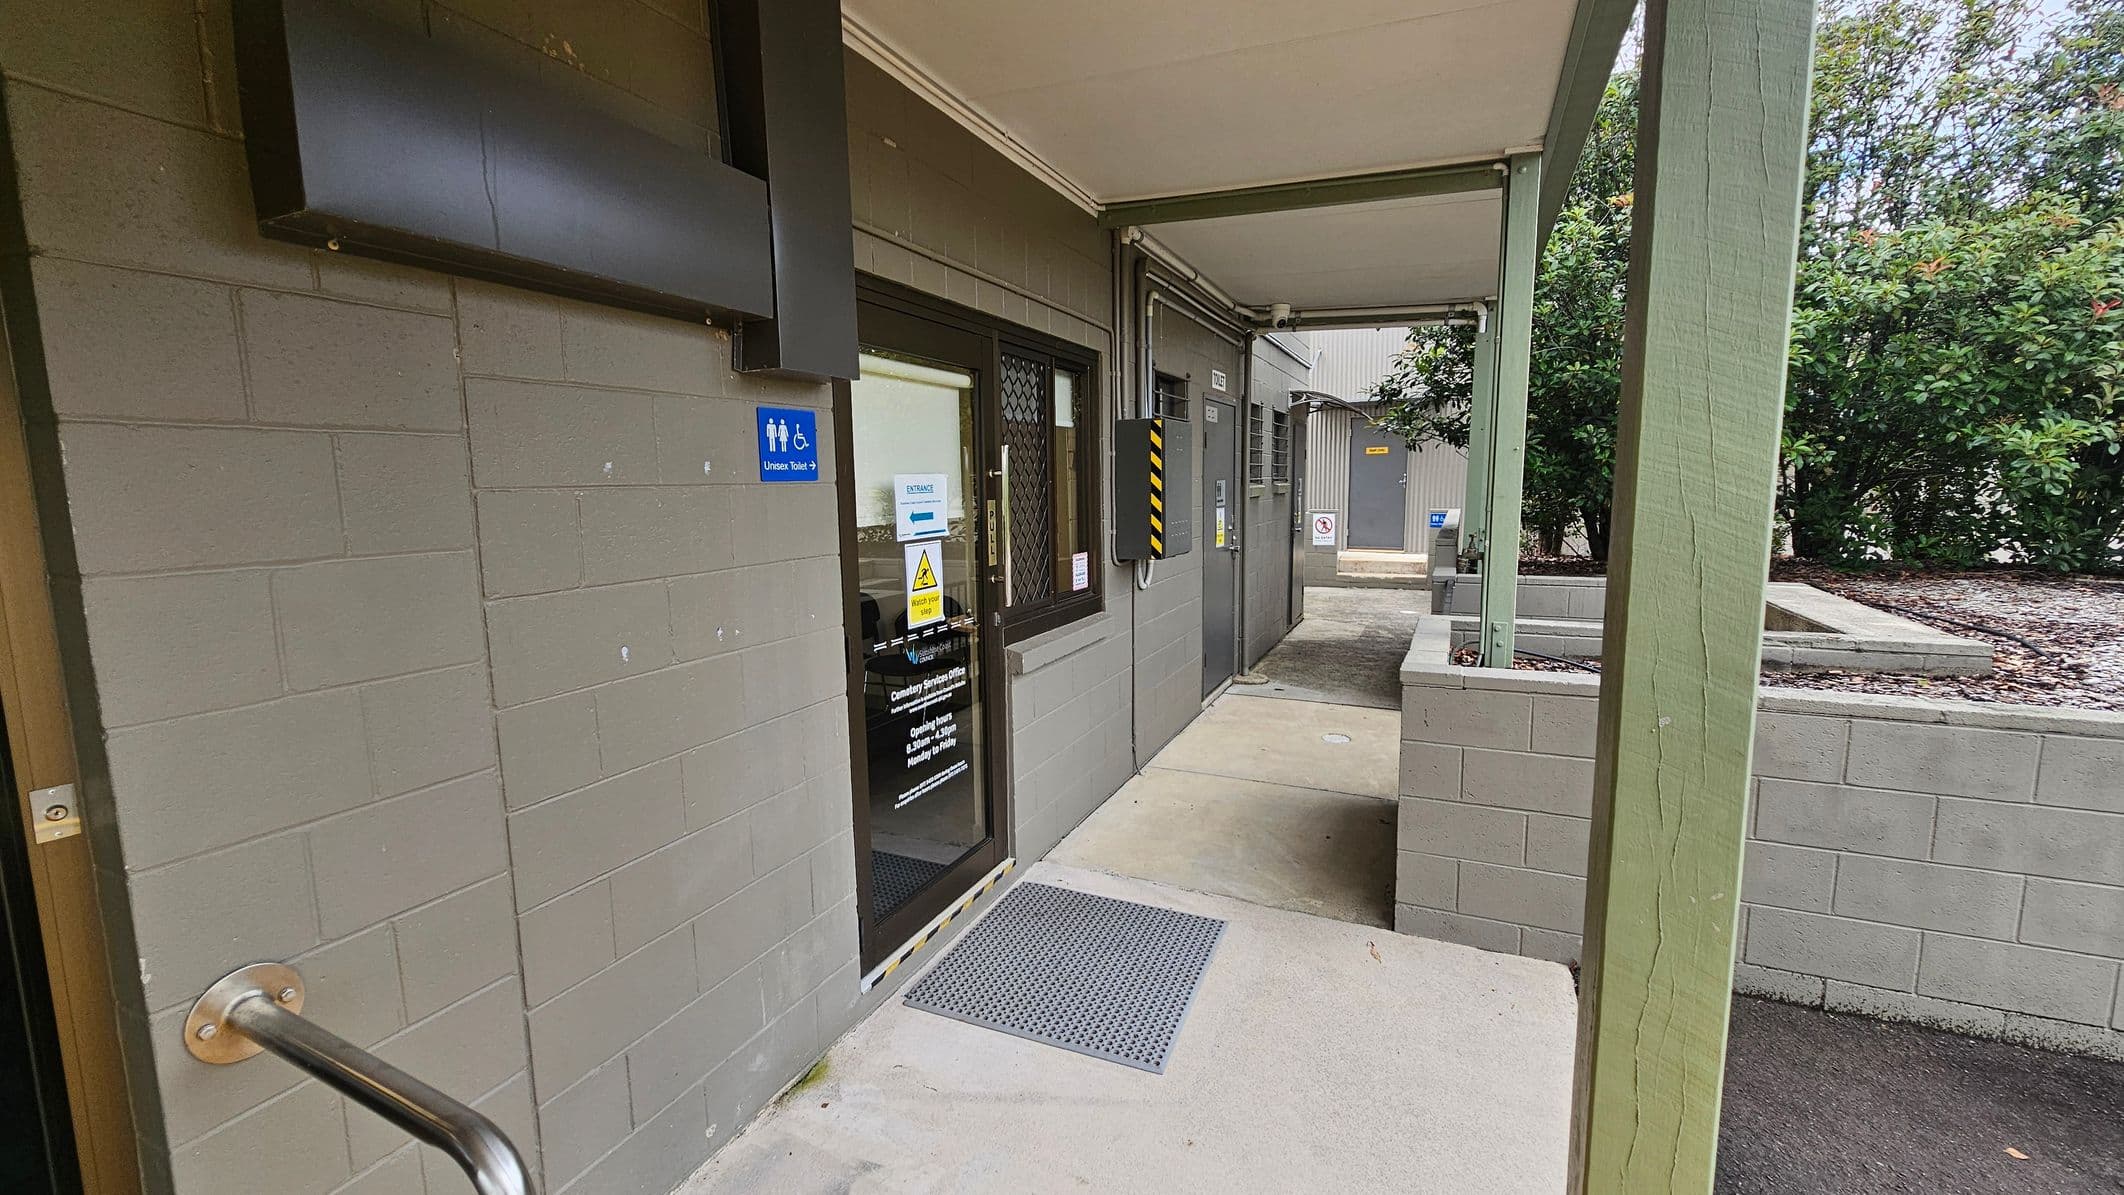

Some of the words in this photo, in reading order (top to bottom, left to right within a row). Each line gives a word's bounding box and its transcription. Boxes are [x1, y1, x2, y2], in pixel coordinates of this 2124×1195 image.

[764, 461, 788, 471] Unisex
[789, 461, 808, 471] Toilet
[906, 484, 934, 493] ENTRANCE
[911, 597, 928, 607] Watch
[928, 595, 940, 604] your
[920, 608, 932, 616] step
[890, 683, 923, 702] Cemetery
[923, 673, 949, 690] Services
[948, 666, 966, 679] Office
[910, 720, 936, 739] Opening
[936, 711, 953, 727] hours
[935, 723, 957, 739] 4.30pm
[907, 749, 932, 768] Monday
[932, 745, 940, 756] to
[940, 736, 957, 751] Friday
